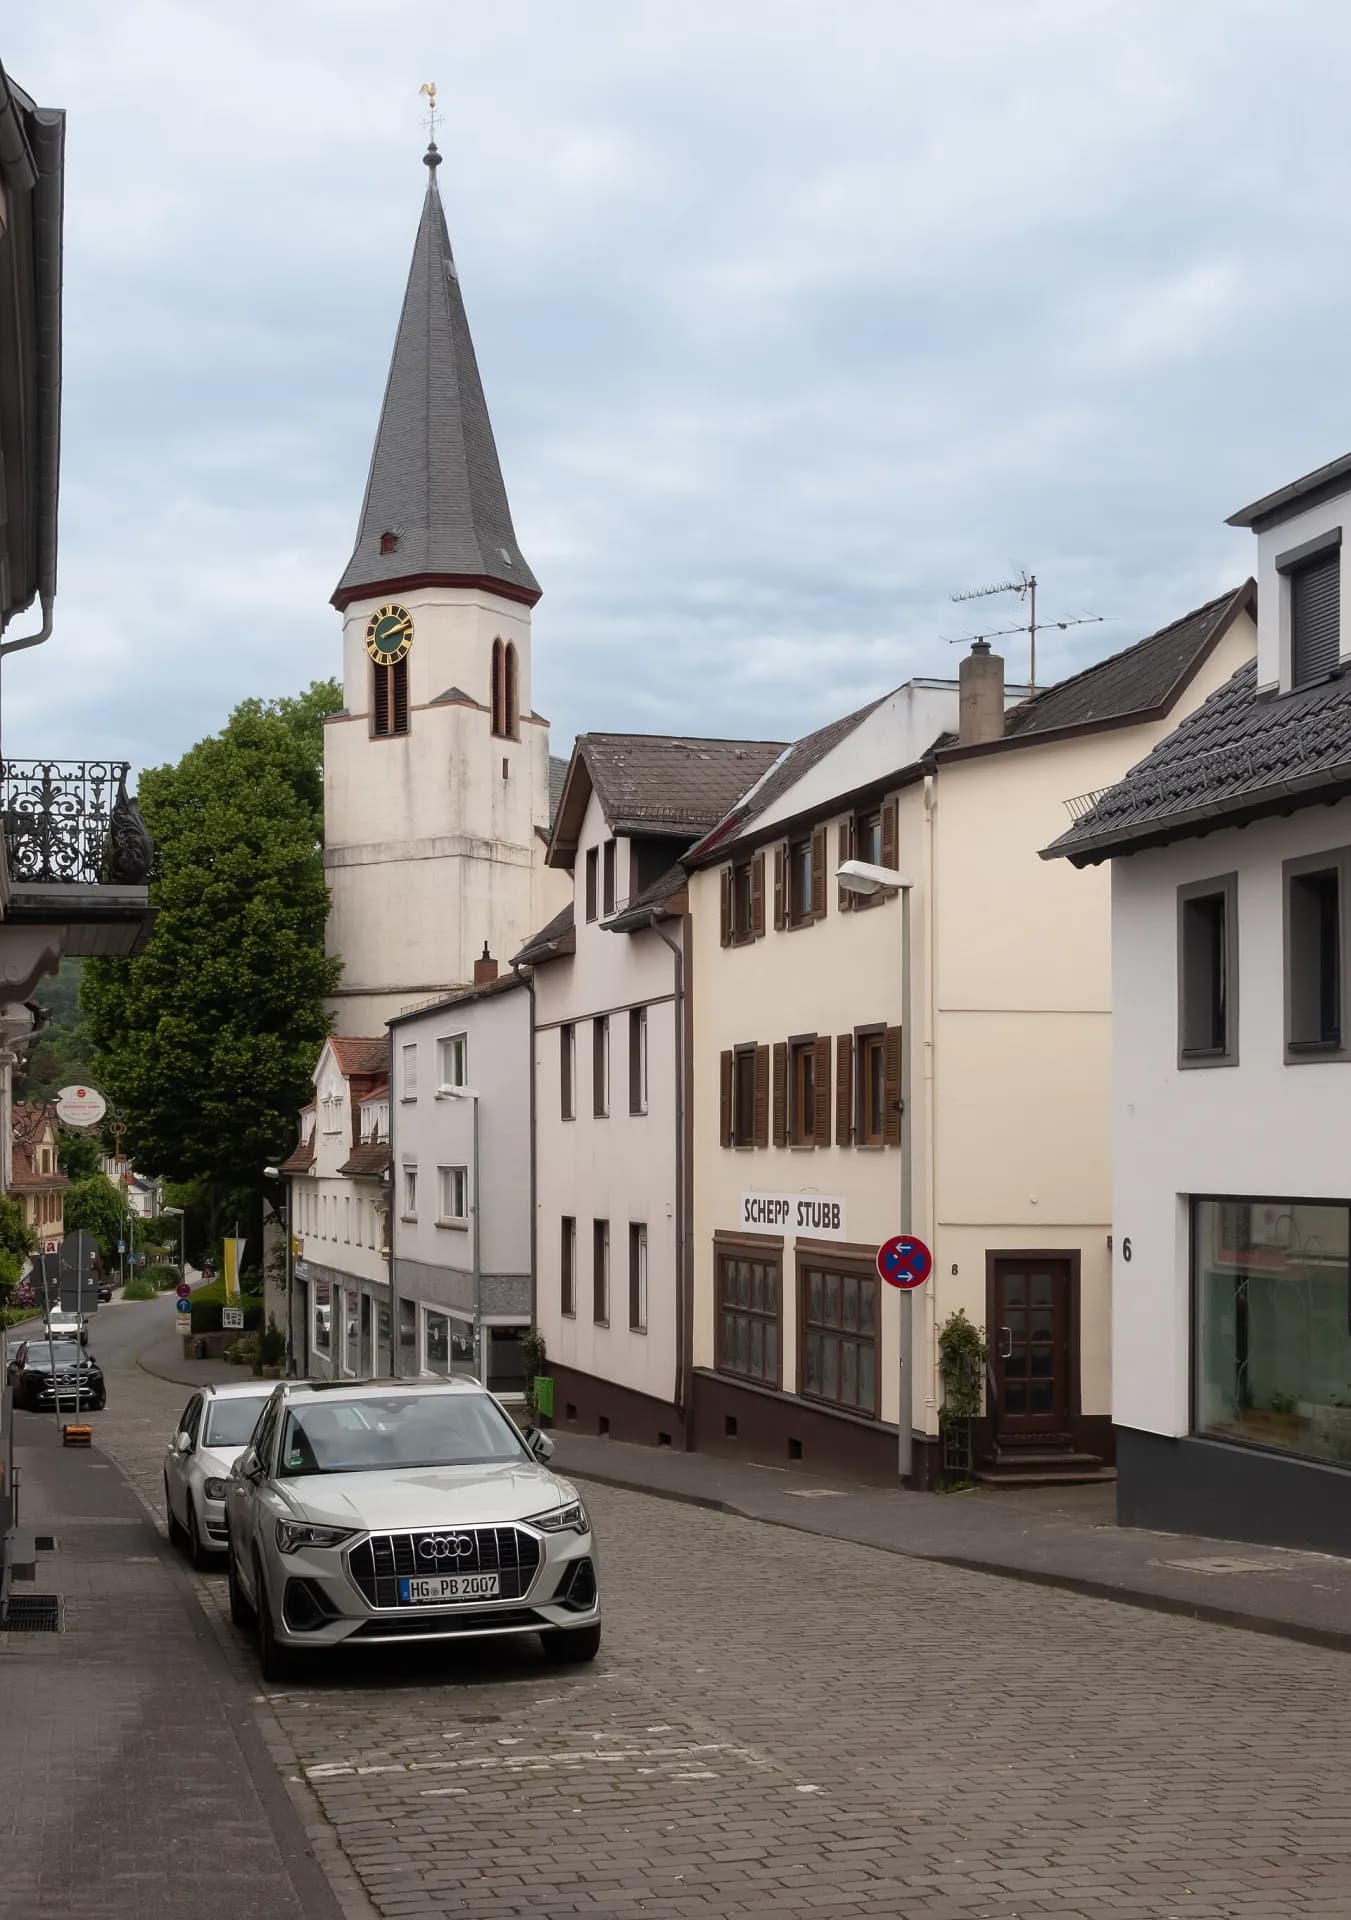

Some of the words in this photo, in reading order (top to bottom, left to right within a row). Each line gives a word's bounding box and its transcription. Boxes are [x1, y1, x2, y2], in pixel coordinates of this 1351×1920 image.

[744, 1198, 790, 1225] SCHEPP
[797, 1200, 841, 1229] STUBB
[1123, 1237, 1132, 1263] 6
[951, 1264, 959, 1276] 8
[410, 1581, 430, 1597] HG
[440, 1579, 459, 1595] PB
[462, 1576, 497, 1594] 2007
